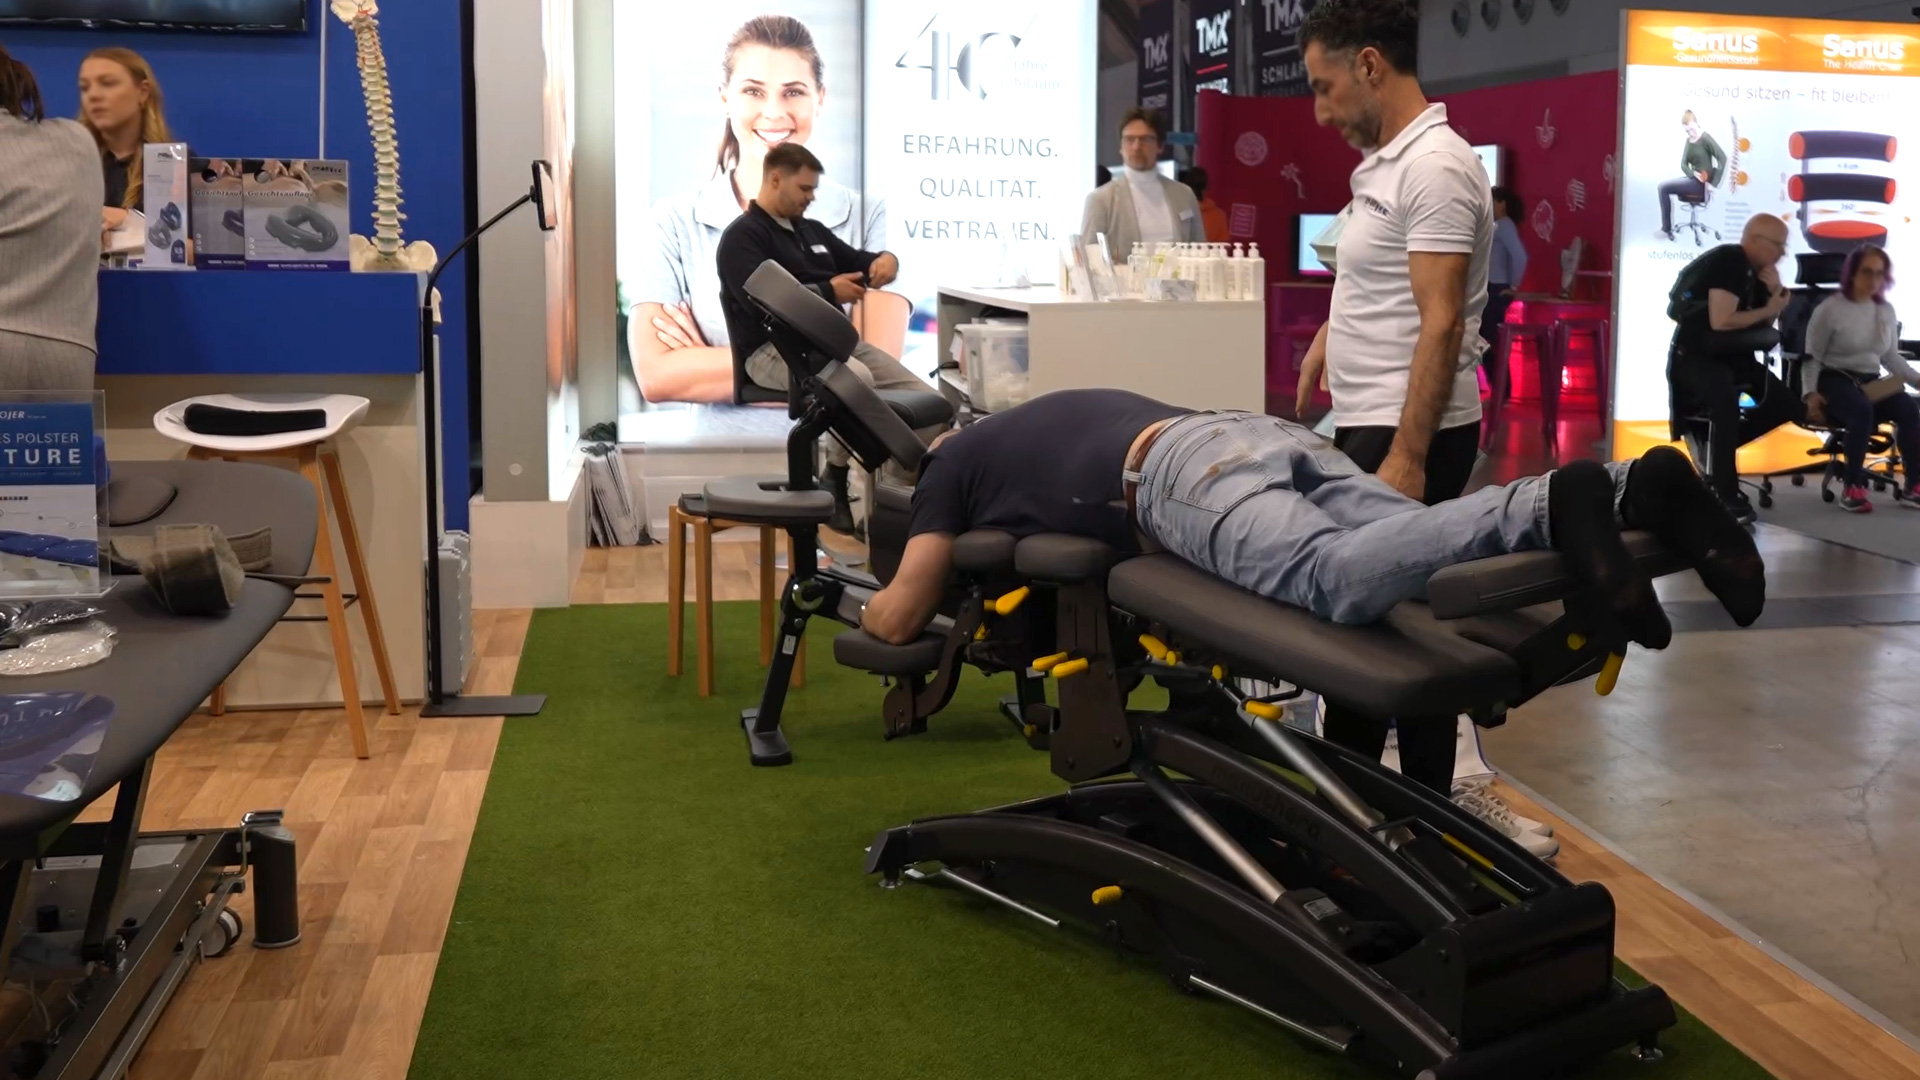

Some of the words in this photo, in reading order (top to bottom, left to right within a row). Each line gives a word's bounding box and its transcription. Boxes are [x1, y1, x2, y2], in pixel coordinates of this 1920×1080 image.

[1195, 9, 1231, 54] TMX
[1672, 26, 1760, 53] Sanus
[1143, 33, 1169, 69] TMX
[1822, 33, 1905, 60] Sanus
[1745, 85, 1791, 102] sitzen
[1810, 87, 1828, 104] fit
[903, 134, 1058, 158] ERFAHRUNG.
[919, 175, 1042, 200] QUALITÄT.
[1647, 248, 1695, 262] stufenlos
[16, 432, 80, 444] POLSTER
[3, 448, 82, 465] TURE
